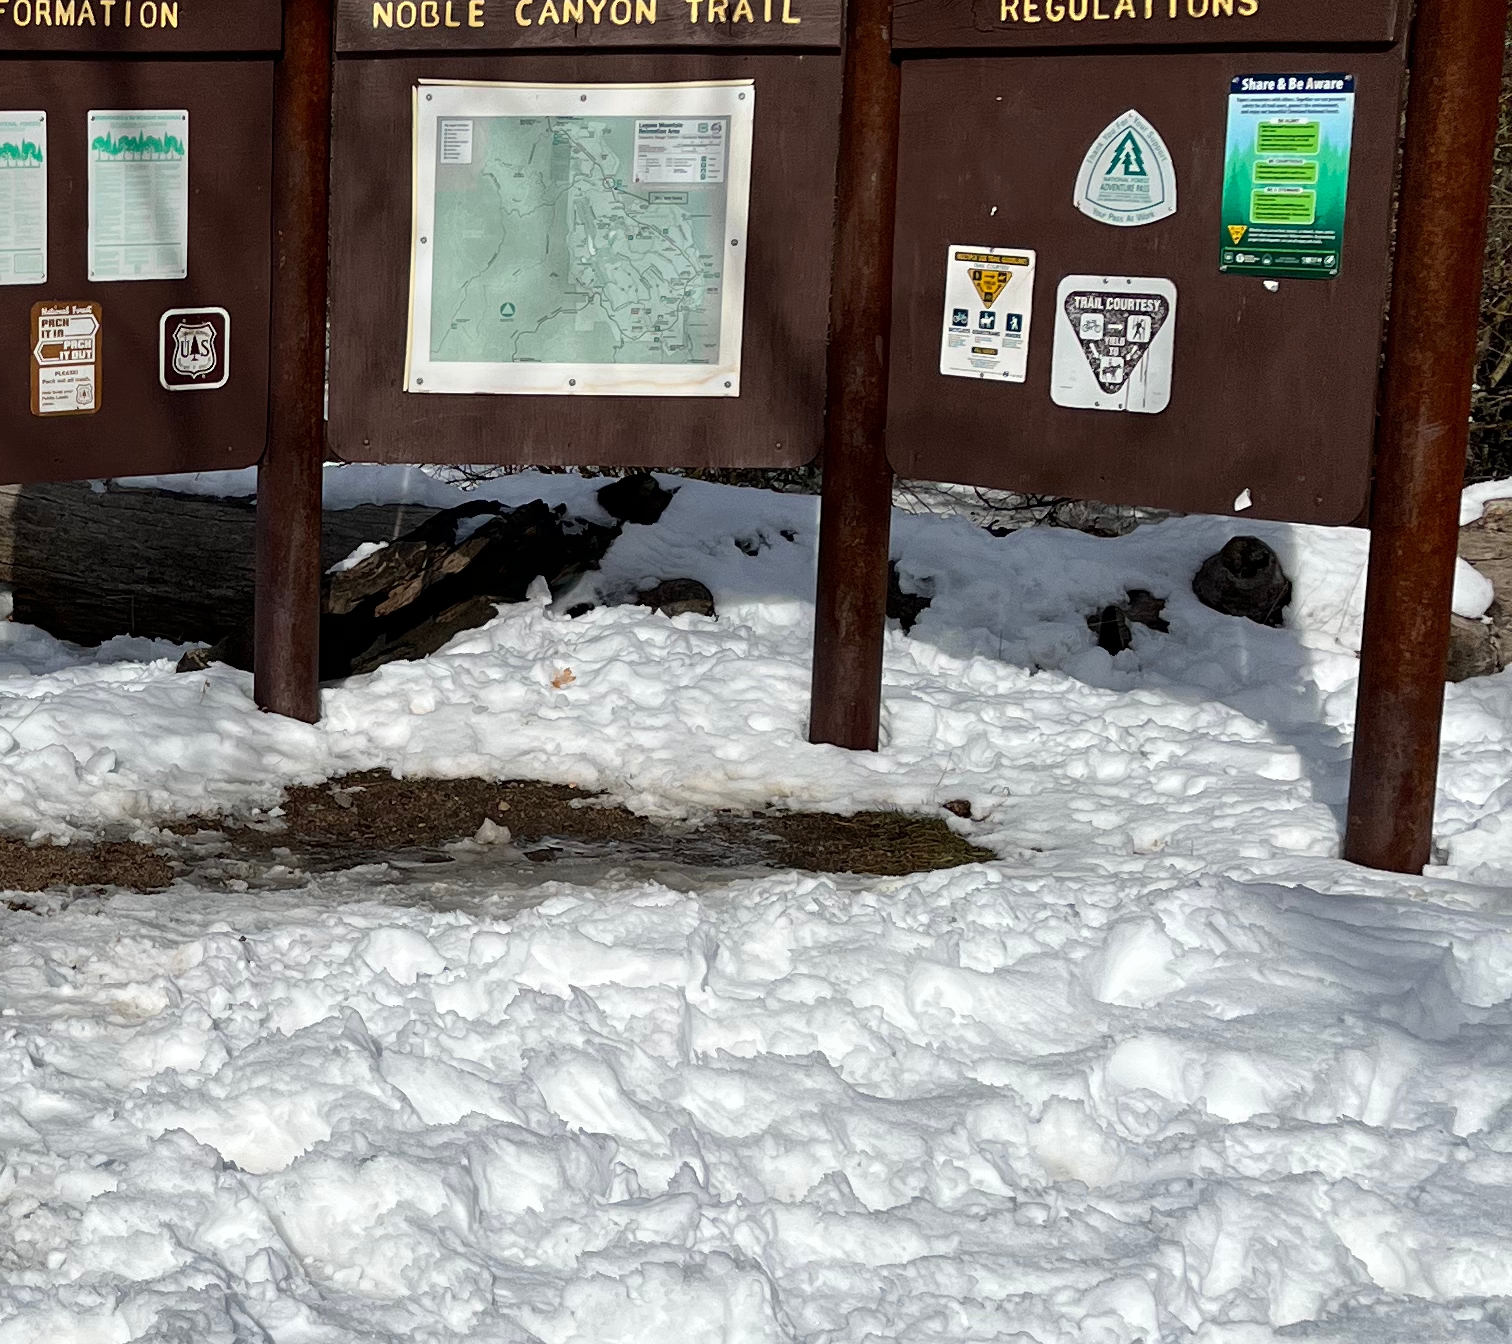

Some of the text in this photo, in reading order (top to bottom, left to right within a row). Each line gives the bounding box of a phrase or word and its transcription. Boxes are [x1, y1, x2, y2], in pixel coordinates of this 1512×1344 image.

[372, 0, 486, 28] NOBLE
[1241, 76, 1344, 91] Share & Be Aware
[1086, 118, 1129, 164] Thank You For
[1132, 116, 1168, 162] Your Support
[1099, 183, 1135, 192] ADVENTURE
[1108, 212, 1124, 223] Pass
[1137, 212, 1155, 222] Work
[1074, 296, 1161, 312] TRAIL COURTESY
[41, 318, 70, 328] PACK
[41, 329, 64, 338] IT IN
[63, 339, 92, 350] PACK
[1104, 336, 1126, 346] YIELD
[59, 349, 93, 360] IT OUT
[1108, 346, 1119, 356] TO
